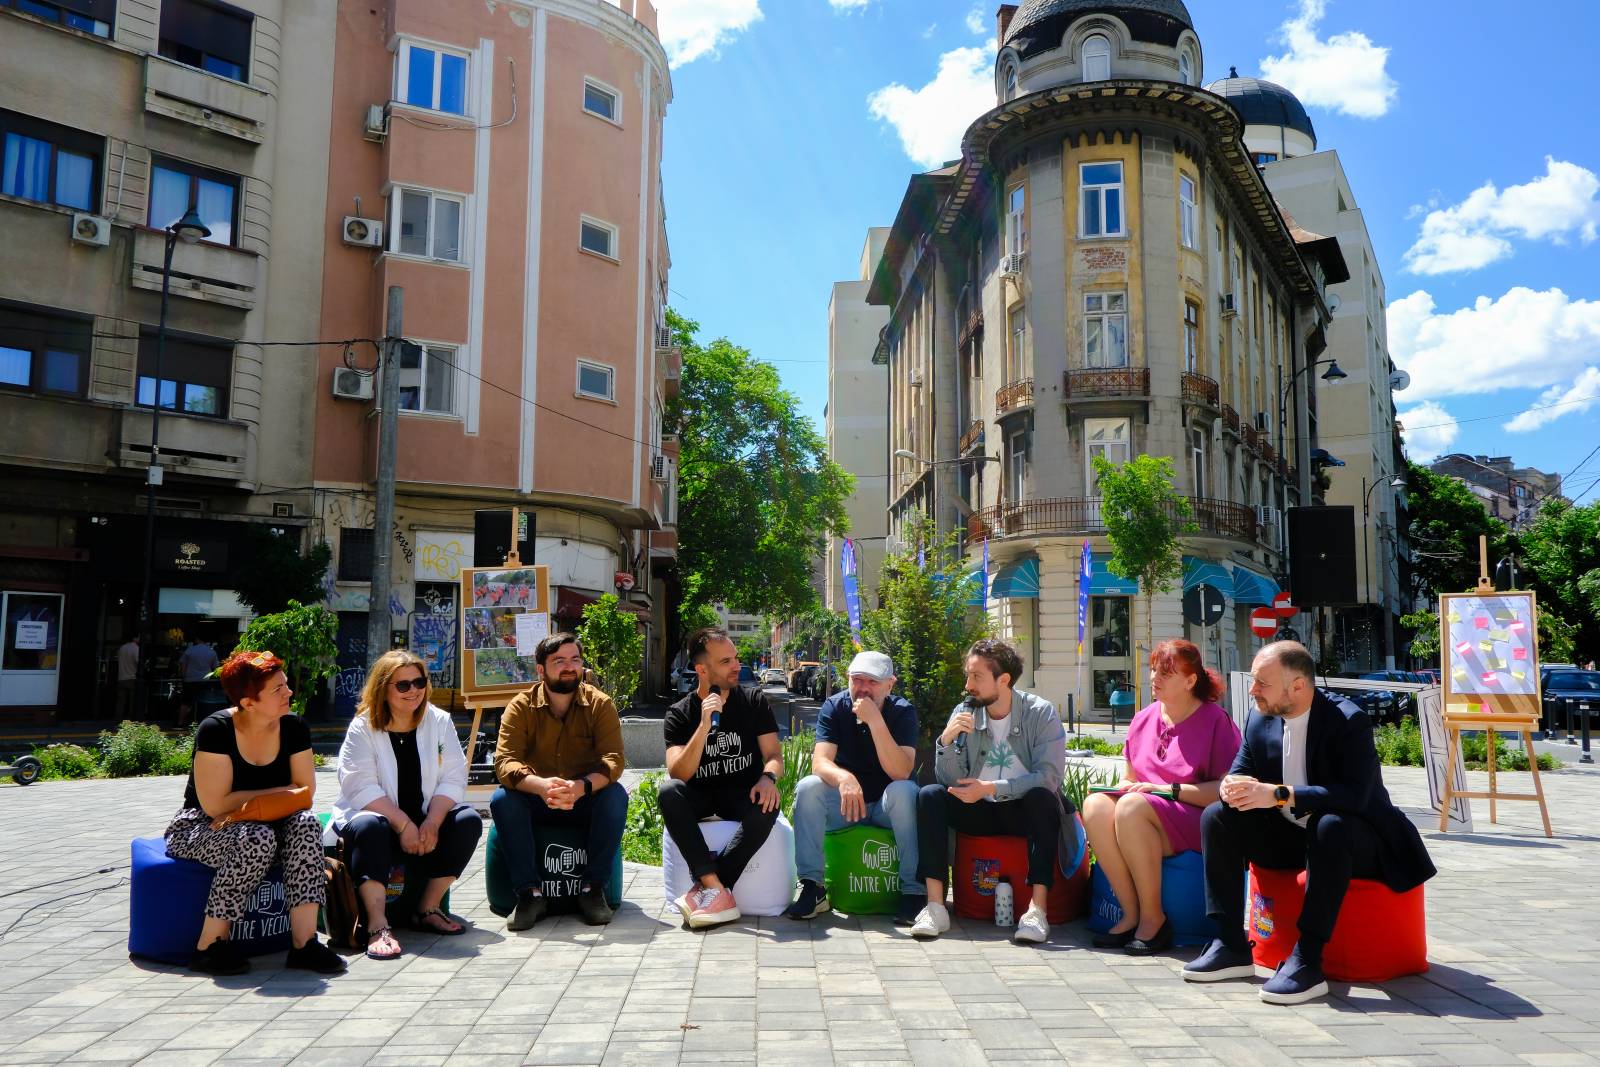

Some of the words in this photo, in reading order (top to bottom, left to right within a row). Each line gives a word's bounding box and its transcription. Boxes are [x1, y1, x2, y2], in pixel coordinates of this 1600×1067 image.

[722, 752, 753, 774] VECINI
[541, 880, 562, 897] TRE
[884, 876, 902, 892] VEC
[229, 919, 257, 941] NTRE
[261, 914, 292, 937] VECIN
